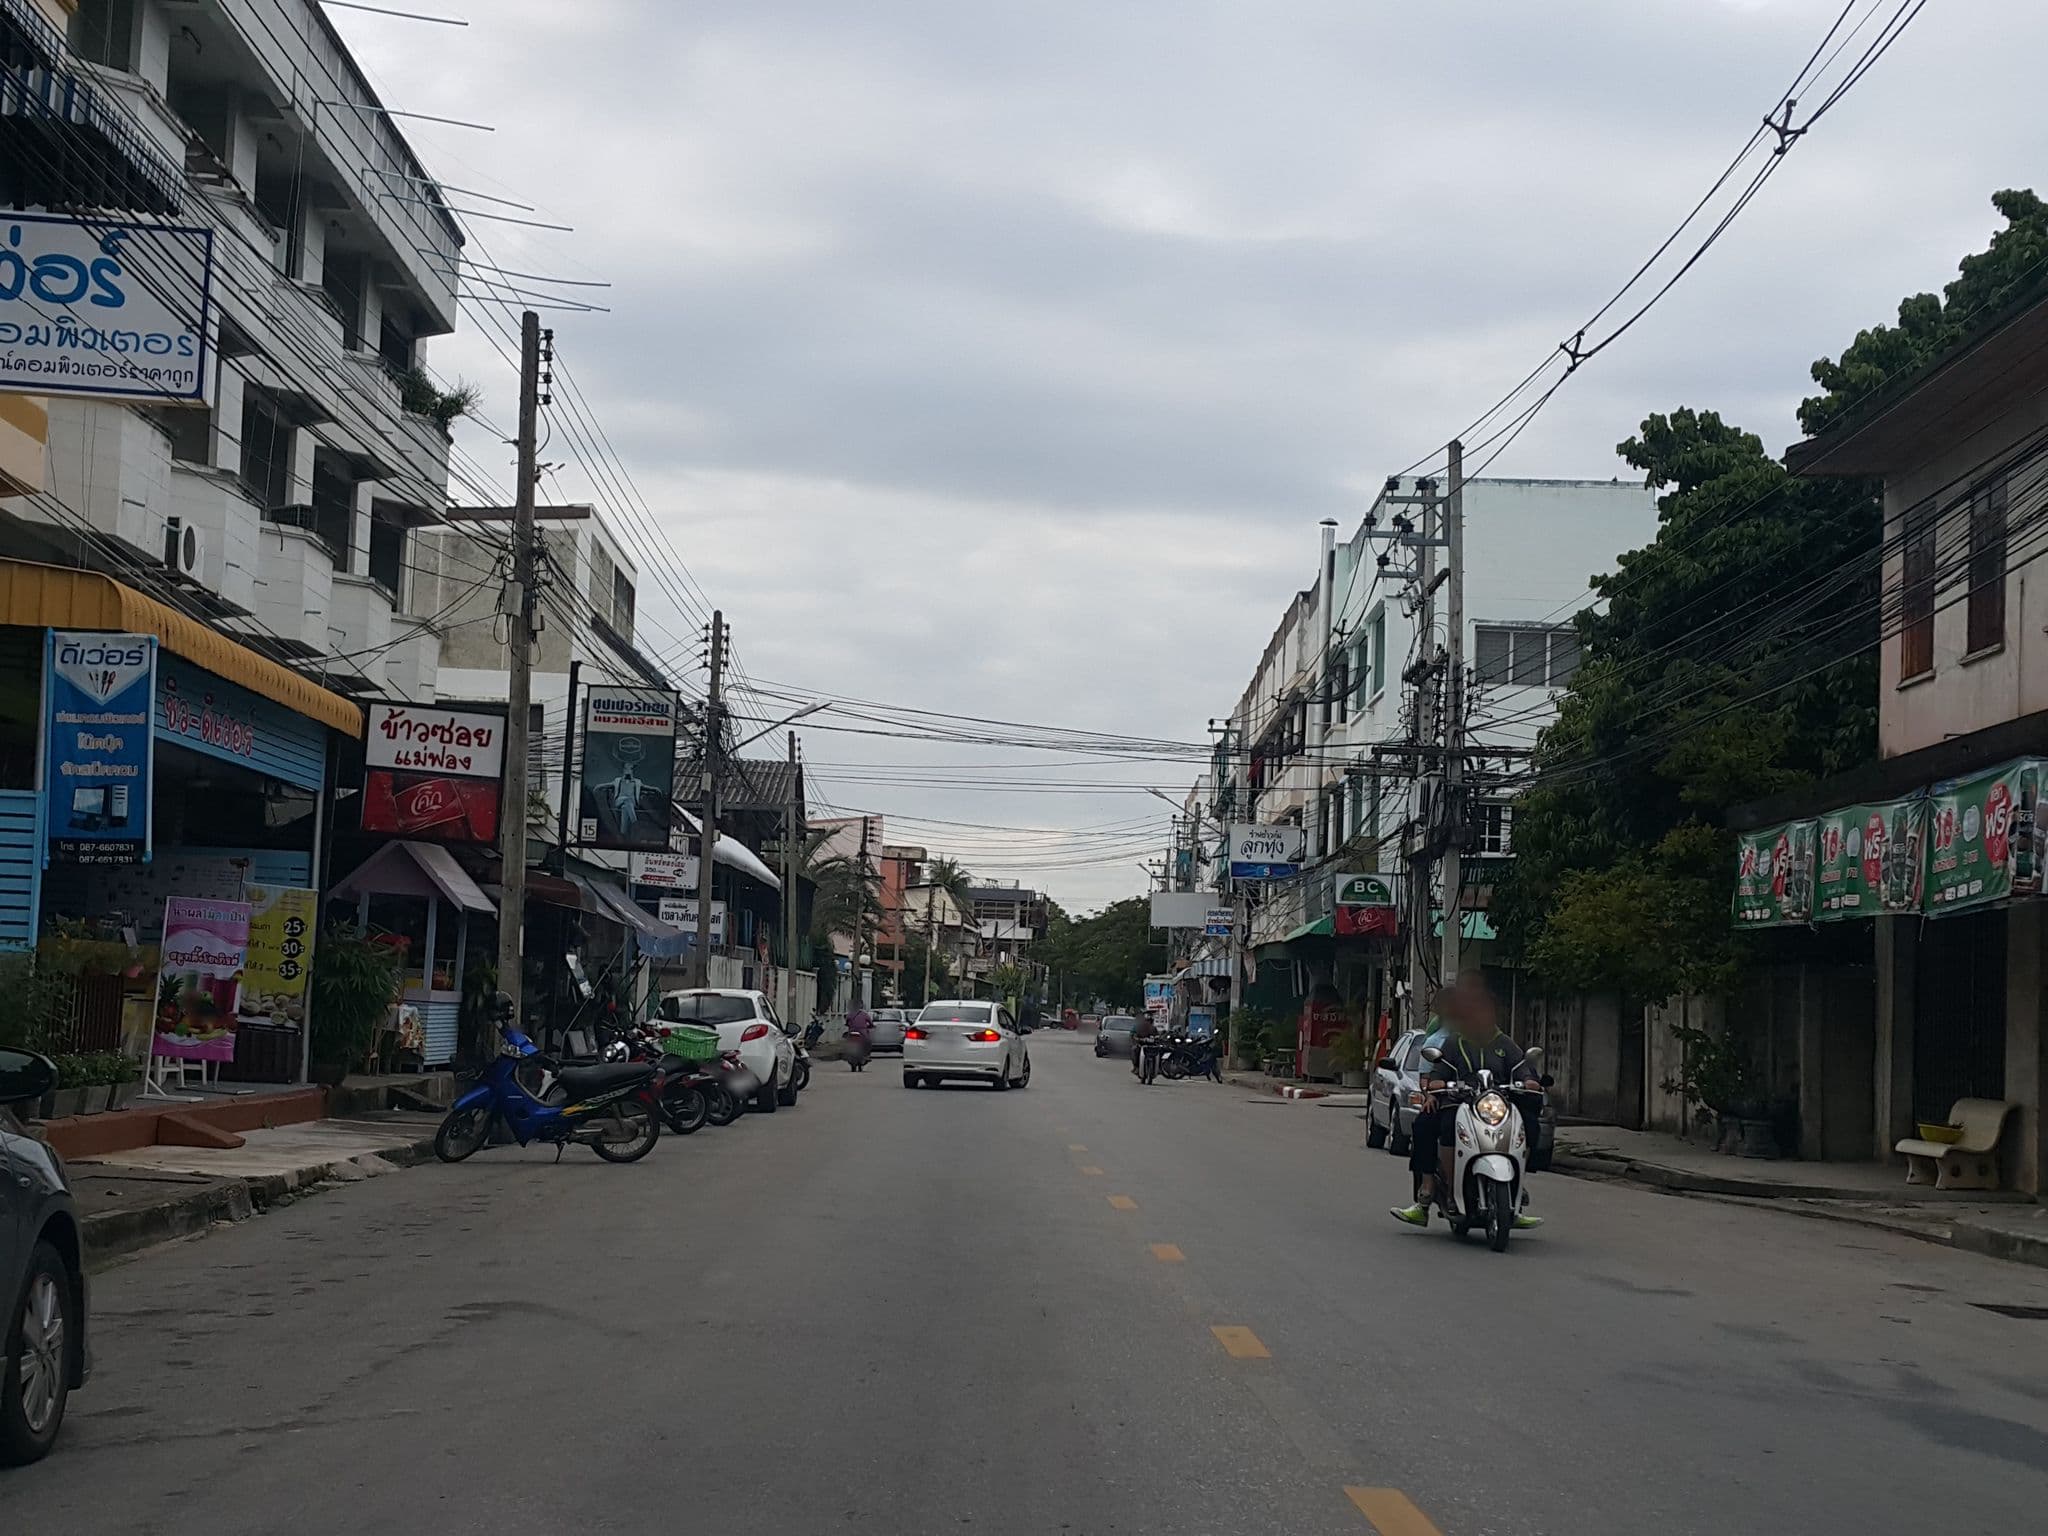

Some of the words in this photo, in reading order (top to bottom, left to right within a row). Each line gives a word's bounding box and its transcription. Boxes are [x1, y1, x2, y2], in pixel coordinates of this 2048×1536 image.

[60, 642, 145, 666] ดีเว่อร์
[394, 746, 472, 771] แม่ฟอง
[1240, 839, 1284, 859] ลูกทุ่ง
[1354, 881, 1379, 893] BC
